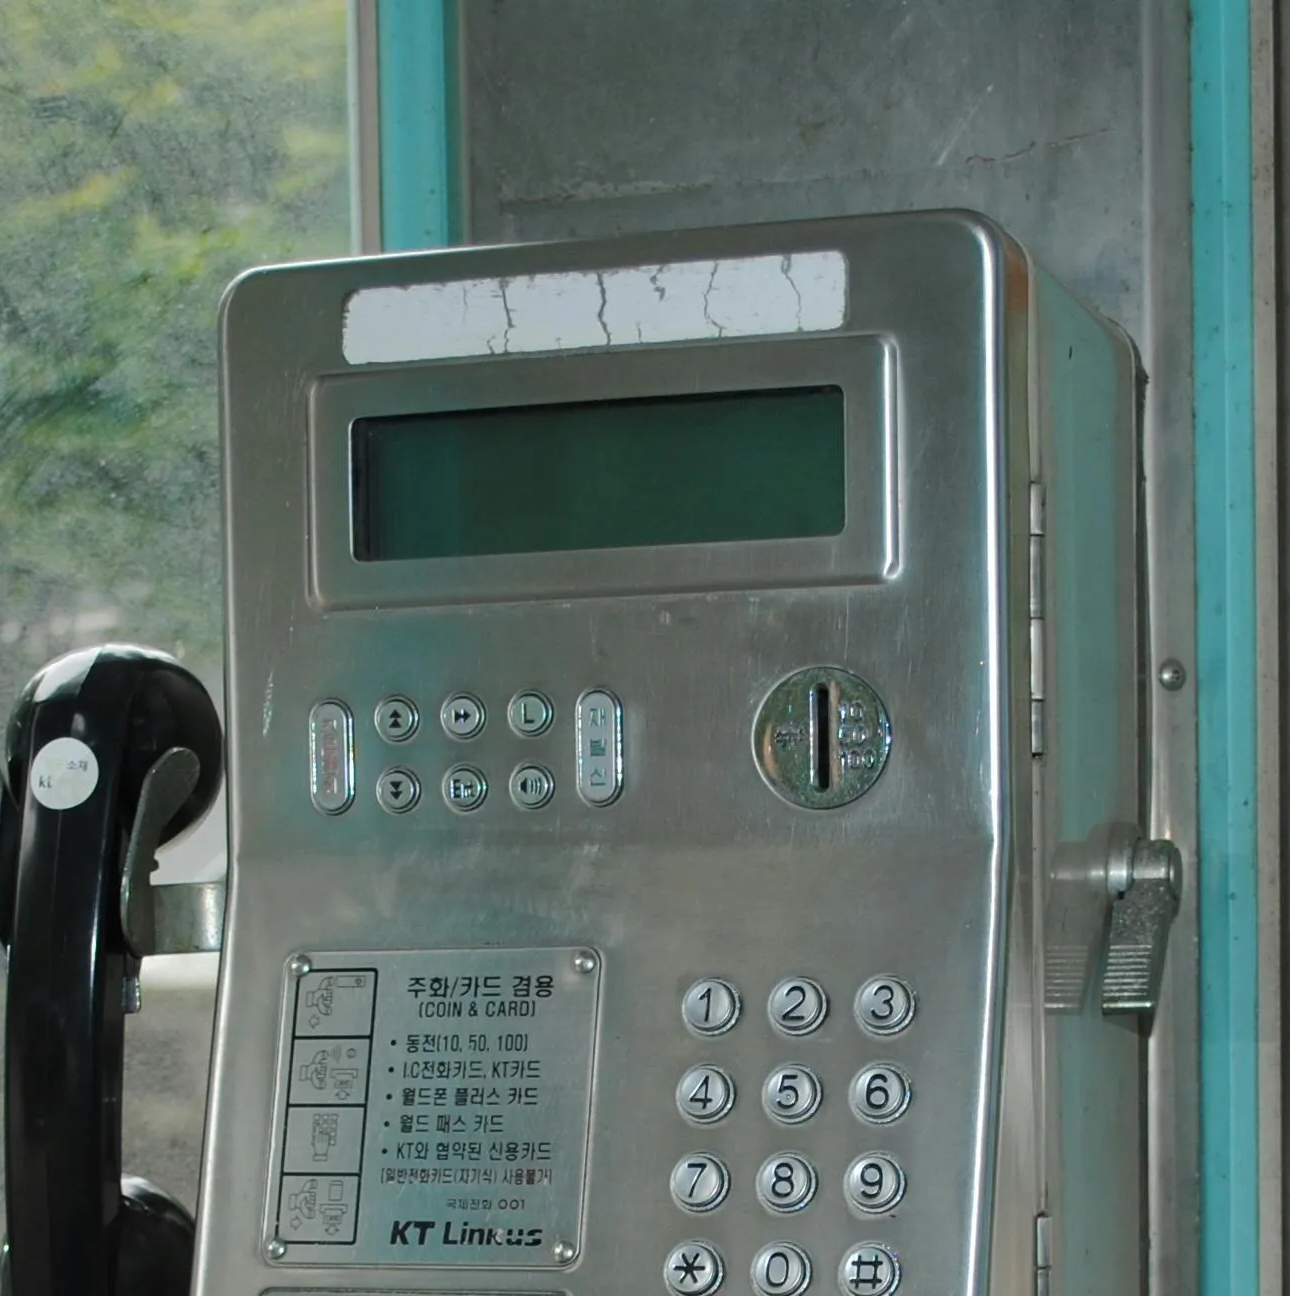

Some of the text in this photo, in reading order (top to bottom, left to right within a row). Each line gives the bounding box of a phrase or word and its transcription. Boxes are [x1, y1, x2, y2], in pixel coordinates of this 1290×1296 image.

[521, 702, 535, 724] L
[407, 974, 555, 999] 주화/카드 겸용
[468, 1002, 479, 1018] &
[698, 984, 895, 1023] 1 2 3
[492, 1060, 541, 1079] KT카드
[402, 1087, 538, 1107] 월드폰 플러스 카드
[688, 1073, 890, 1110] 4 5 6
[400, 1114, 504, 1134] 월드 패스 카드
[397, 1142, 552, 1161] KT와 협약된 신용카드
[686, 1161, 884, 1199] 7 8 9
[498, 1199, 526, 1211] 001
[390, 1220, 436, 1246] KT
[765, 1251, 790, 1288] 0
